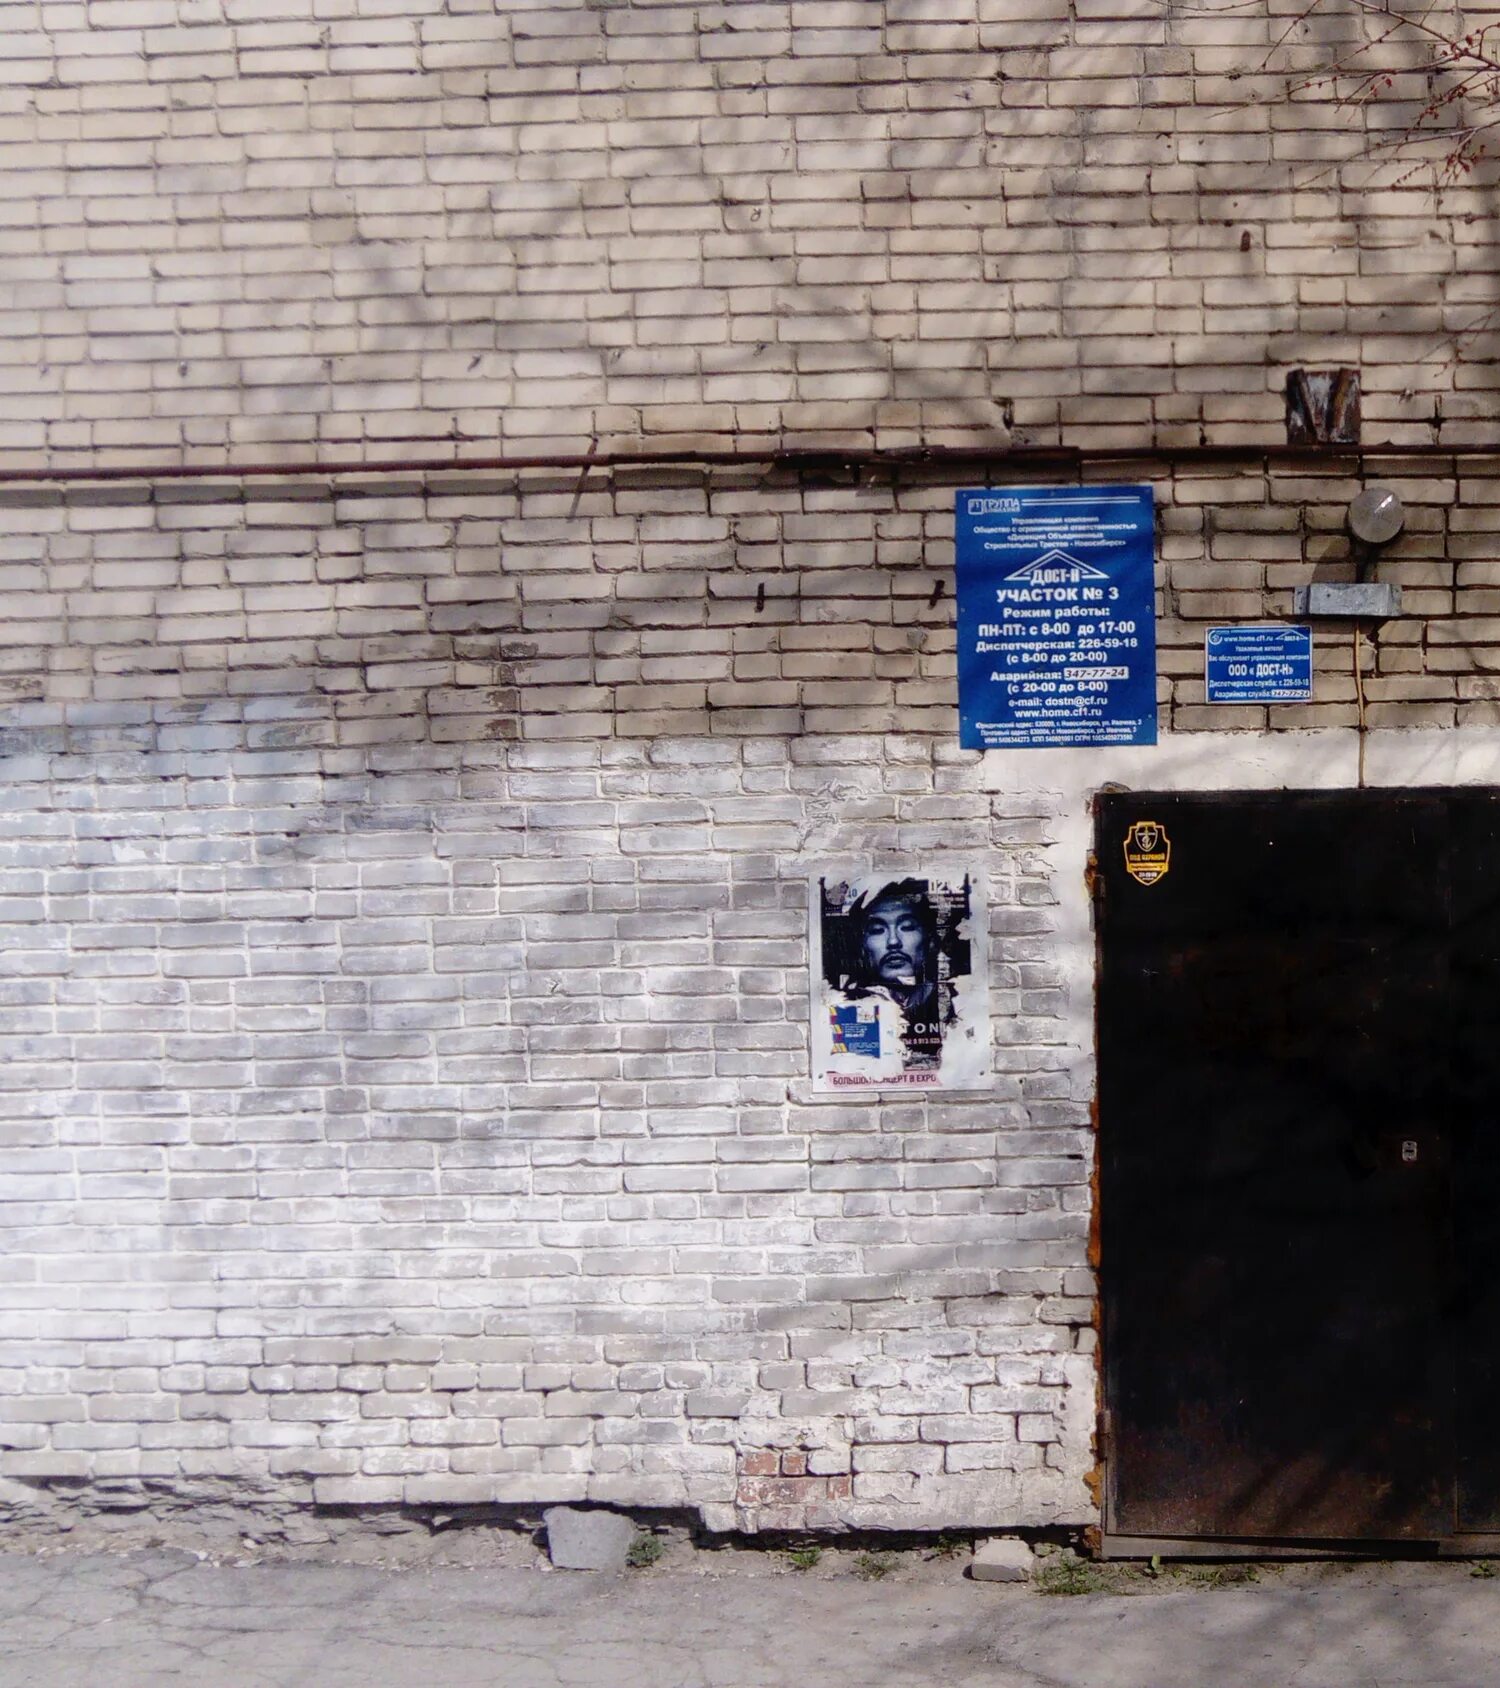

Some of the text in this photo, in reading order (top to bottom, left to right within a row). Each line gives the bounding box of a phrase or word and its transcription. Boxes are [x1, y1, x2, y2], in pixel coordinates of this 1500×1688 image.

[1030, 568, 1080, 586] ДОСТ-Н
[996, 586, 1119, 603] УЧАСТОК № 3
[1003, 606, 1110, 619] Режим работы:
[978, 621, 1136, 637] ПН-ПТ: с 8-00 до 17-00
[976, 638, 1138, 652] Диспетчерская: 226-59-18
[1007, 651, 1107, 665] (с 8-00 до 20-00)
[990, 668, 1125, 682] Аварийная: 347-77-24
[1228, 664, 1247, 676] ООО
[1007, 681, 1108, 695] (с 20-00 до 8-00)
[1008, 696, 1108, 707] e-mail: dostn@cf.ru
[1014, 707, 1102, 718] www.home.cf1.ru
